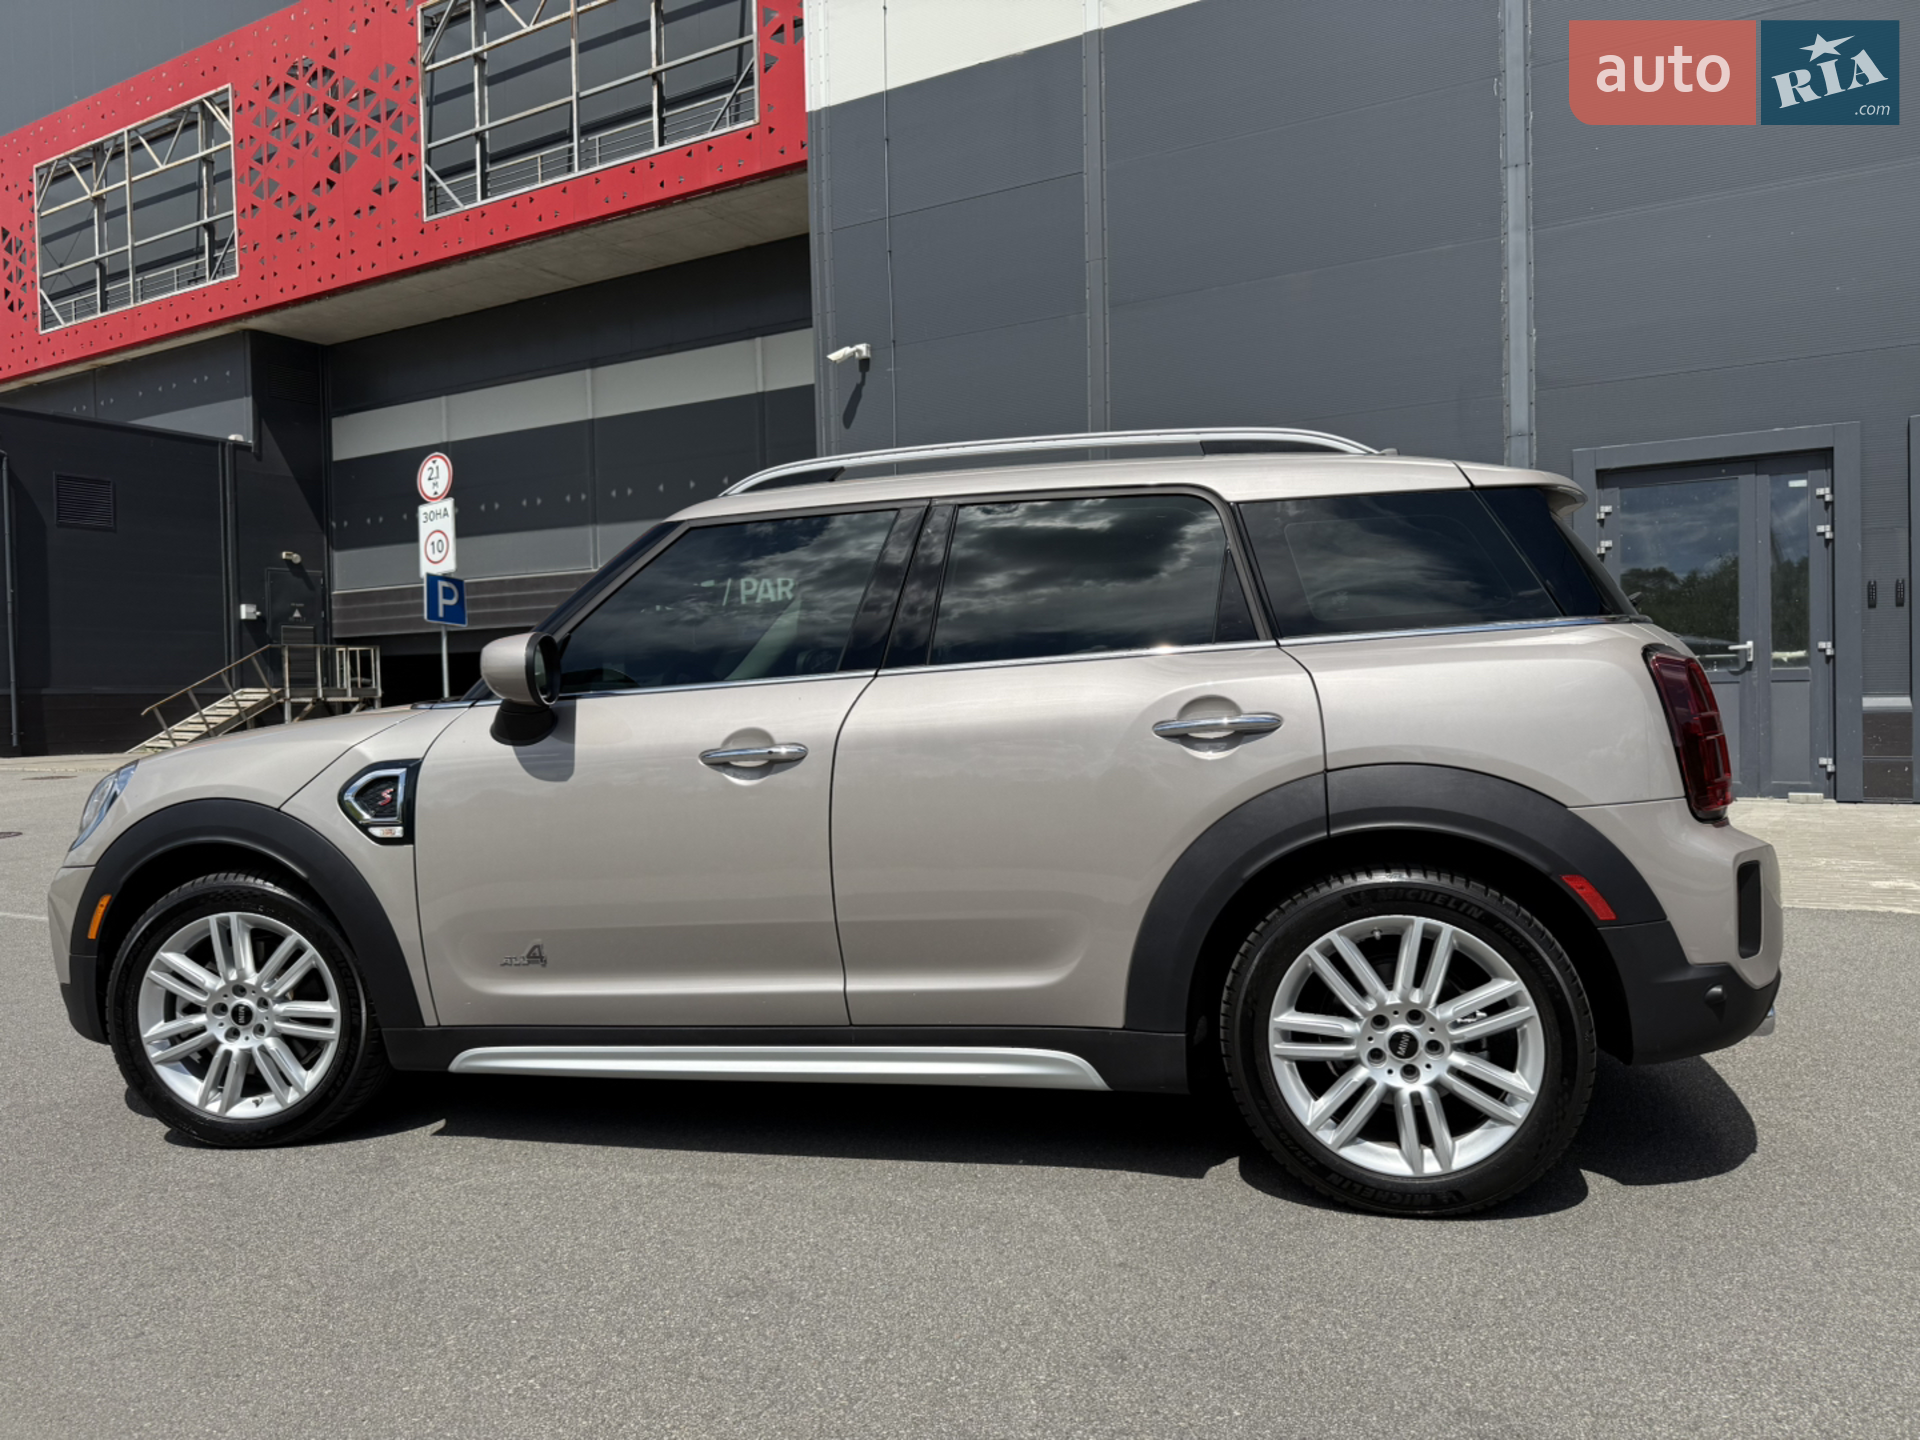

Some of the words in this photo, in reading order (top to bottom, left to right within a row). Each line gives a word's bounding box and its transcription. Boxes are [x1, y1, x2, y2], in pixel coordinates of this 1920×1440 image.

[422, 507, 450, 524] ЗОНА
[430, 539, 444, 554] 10
[437, 579, 459, 618] P
[377, 787, 395, 806] S
[1376, 887, 1484, 921] MICHELIN
[1492, 921, 1529, 950] PILOT
[238, 1006, 246, 1024] MINI
[1396, 1033, 1411, 1057] MINI
[1324, 1171, 1433, 1207] MICHELIN
